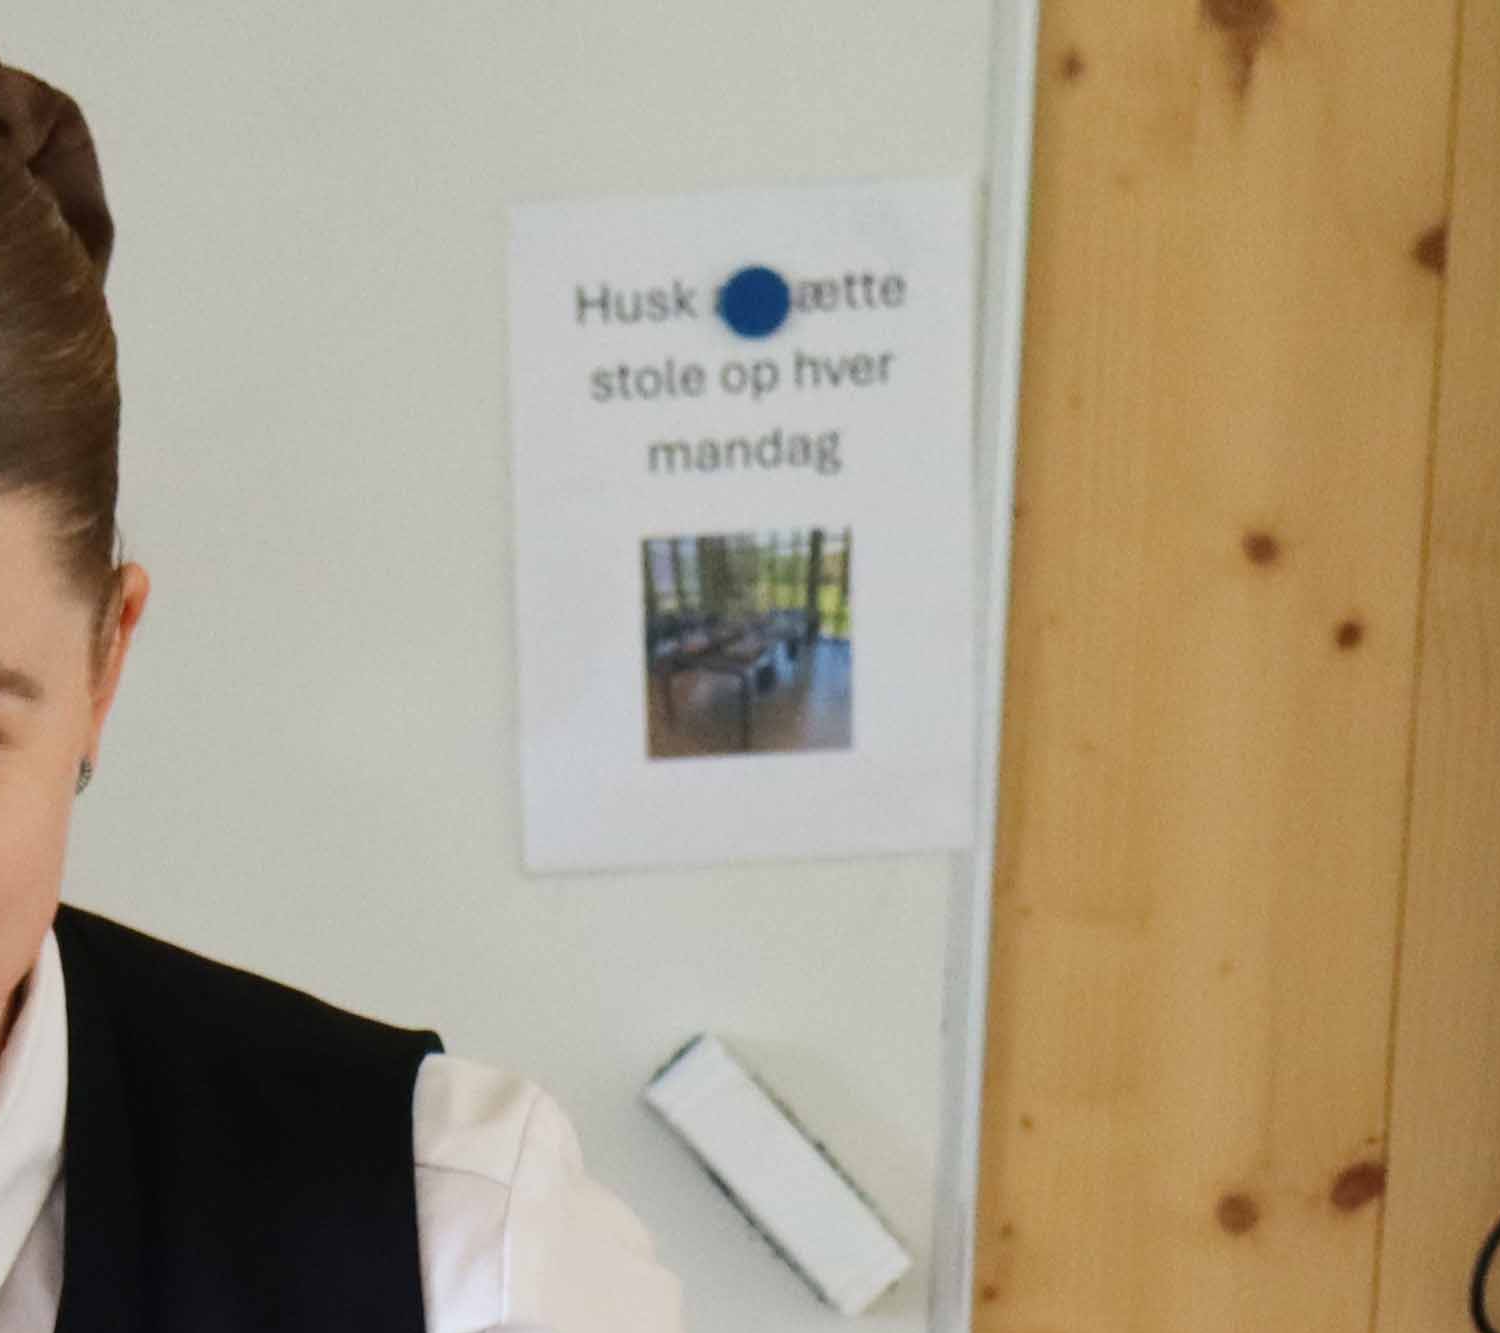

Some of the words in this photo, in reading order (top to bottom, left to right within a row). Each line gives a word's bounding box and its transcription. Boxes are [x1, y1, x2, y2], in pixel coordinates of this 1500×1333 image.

[575, 276, 699, 325] Husk
[788, 271, 906, 314] ætte
[590, 357, 707, 402] stole
[719, 358, 780, 402] op
[793, 350, 894, 388] hver
[647, 427, 843, 476] mandag
